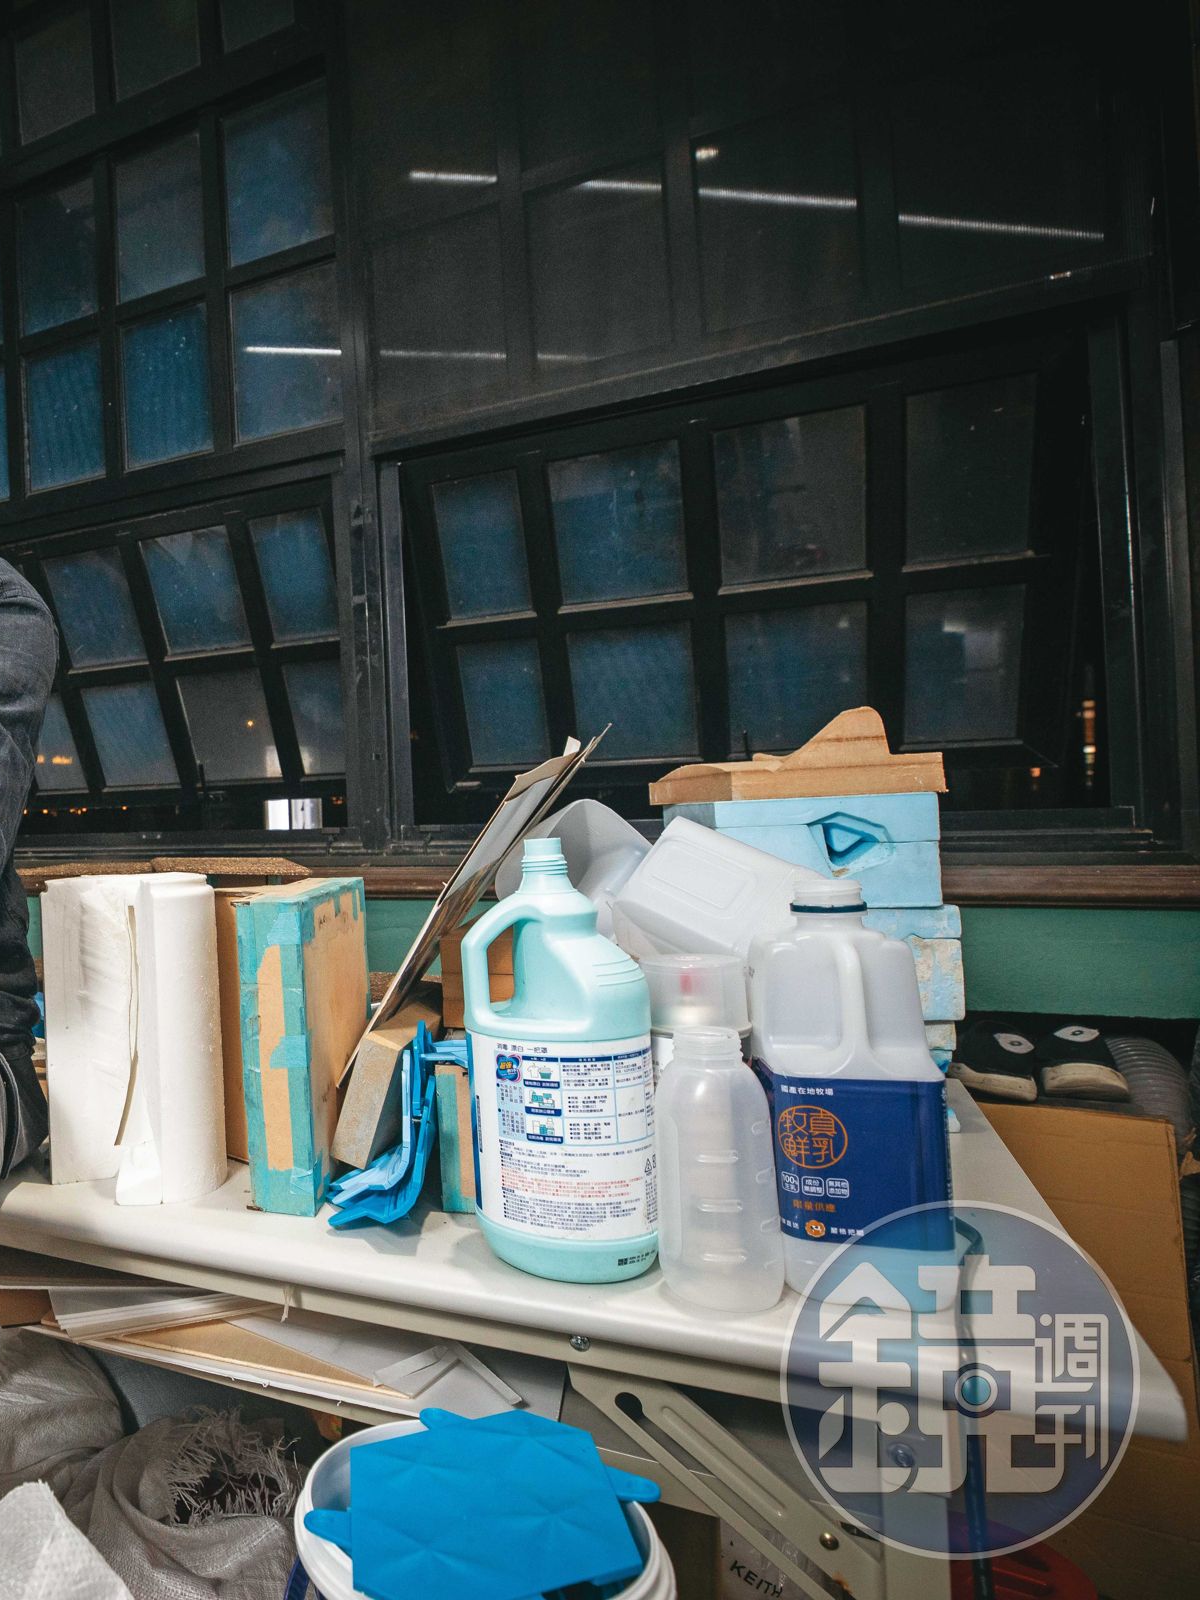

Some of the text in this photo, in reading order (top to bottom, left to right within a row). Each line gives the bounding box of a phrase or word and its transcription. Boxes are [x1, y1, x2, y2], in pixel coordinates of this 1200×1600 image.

[780, 1084, 834, 1097] 國產在地牧場
[729, 1560, 783, 1598] KEITH
